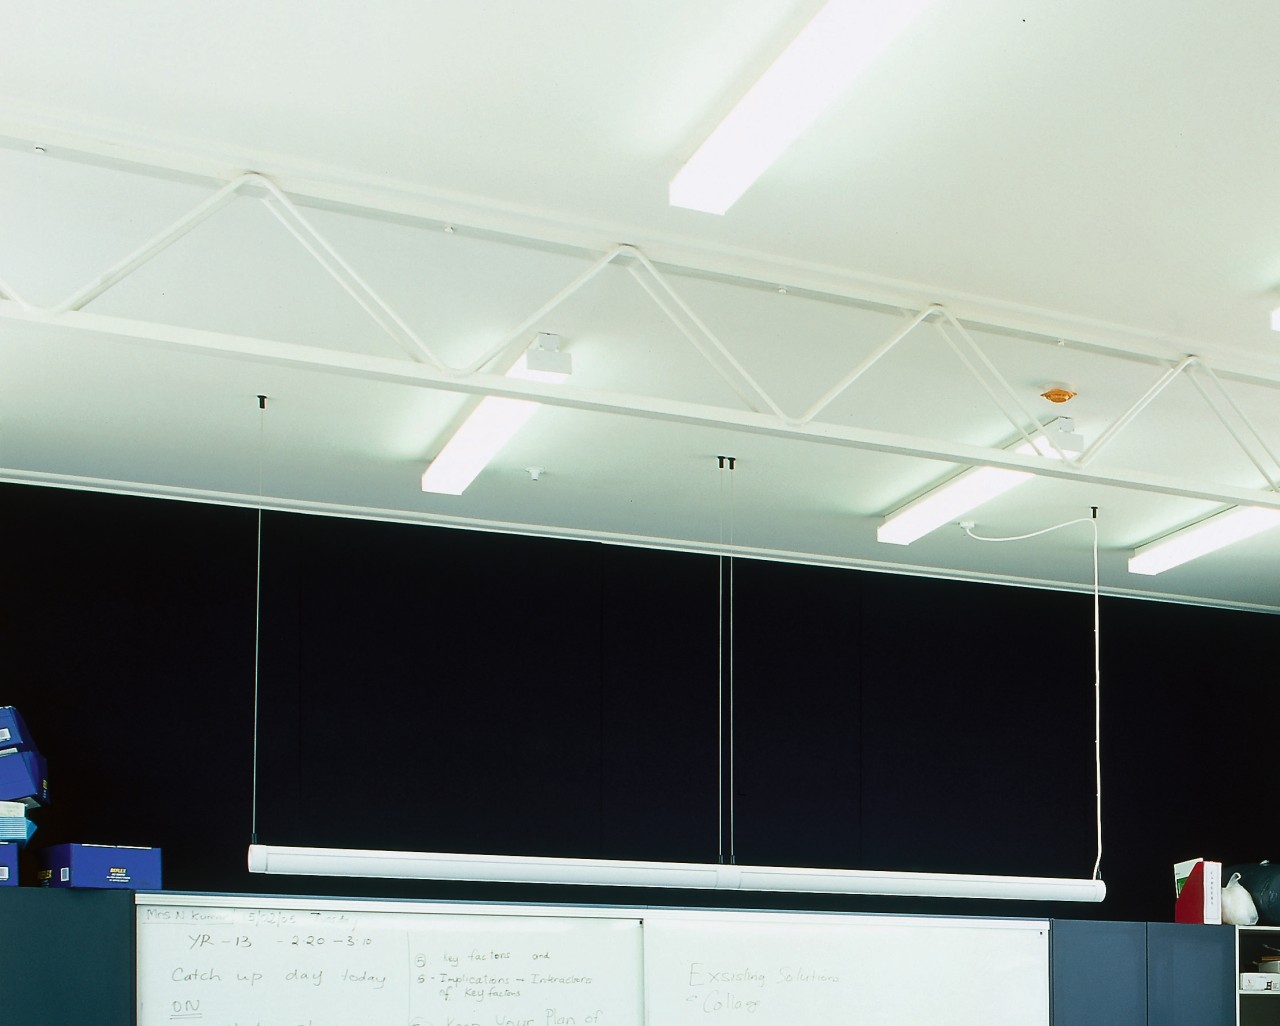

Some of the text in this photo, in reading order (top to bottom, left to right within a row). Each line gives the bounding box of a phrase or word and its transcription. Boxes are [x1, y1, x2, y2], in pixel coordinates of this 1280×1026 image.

[531, 951, 551, 961] and
[171, 966, 387, 991] Catch up day today
[439, 973, 510, 988] Implications
[439, 985, 454, 1001] of
[584, 1008, 605, 1025] of
